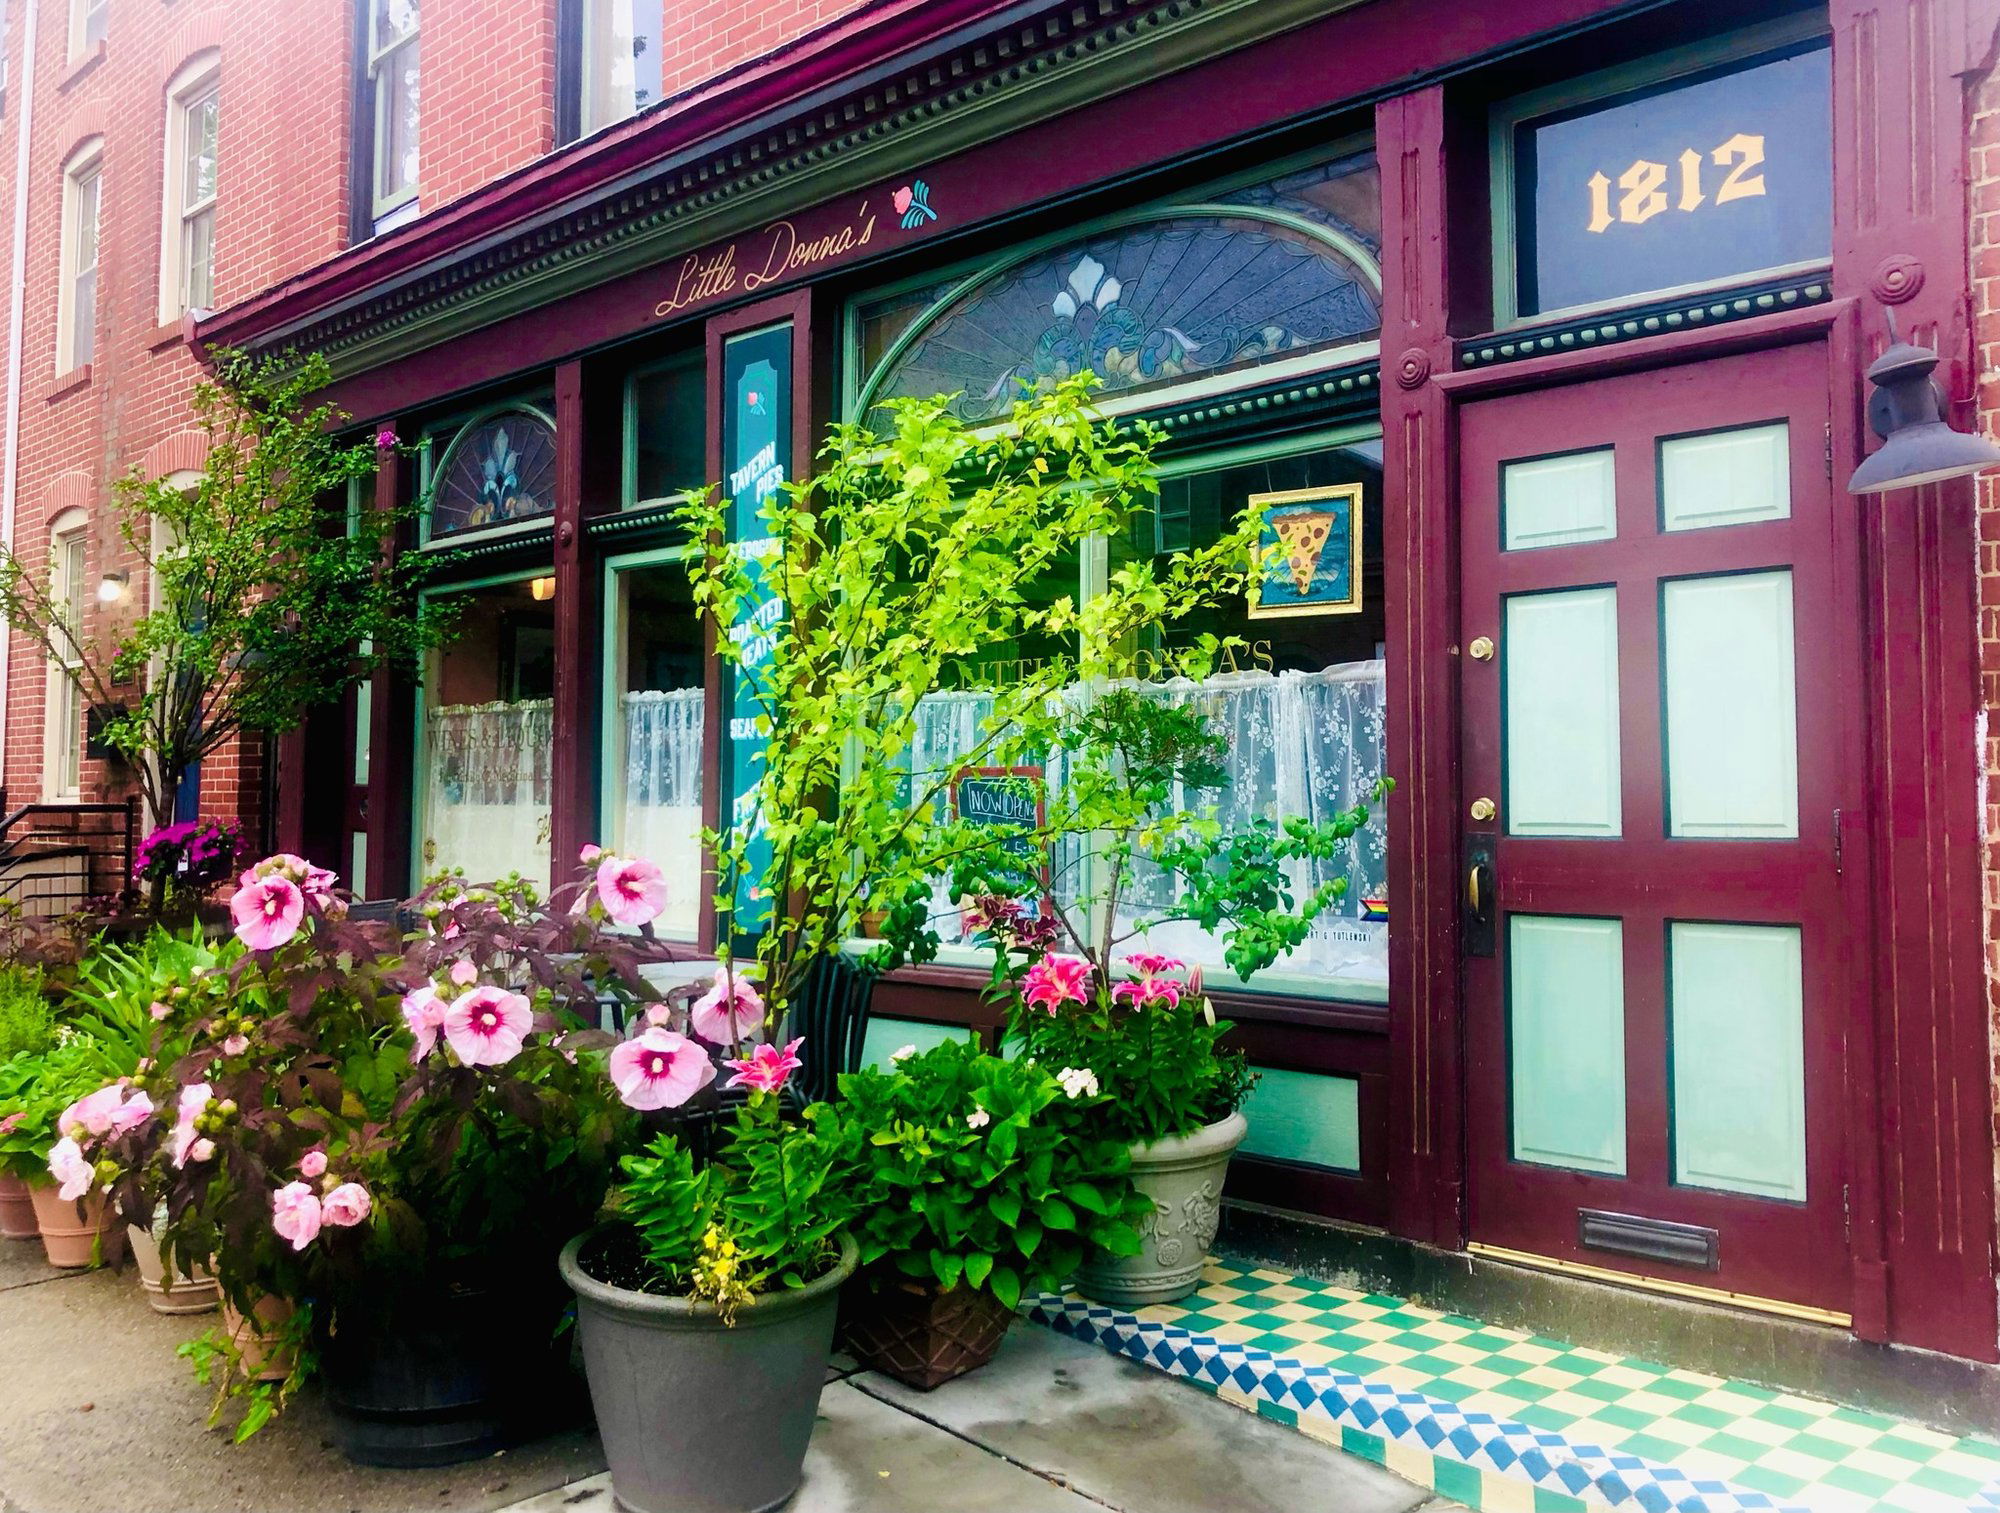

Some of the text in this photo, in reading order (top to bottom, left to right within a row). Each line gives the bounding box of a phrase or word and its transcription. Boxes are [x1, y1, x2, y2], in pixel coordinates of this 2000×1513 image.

[1586, 133, 1767, 234] 1812
[655, 200, 877, 318] Little Donna's
[730, 441, 776, 497] TAVERN
[756, 464, 784, 504] PIES
[971, 790, 1002, 813] NOW
